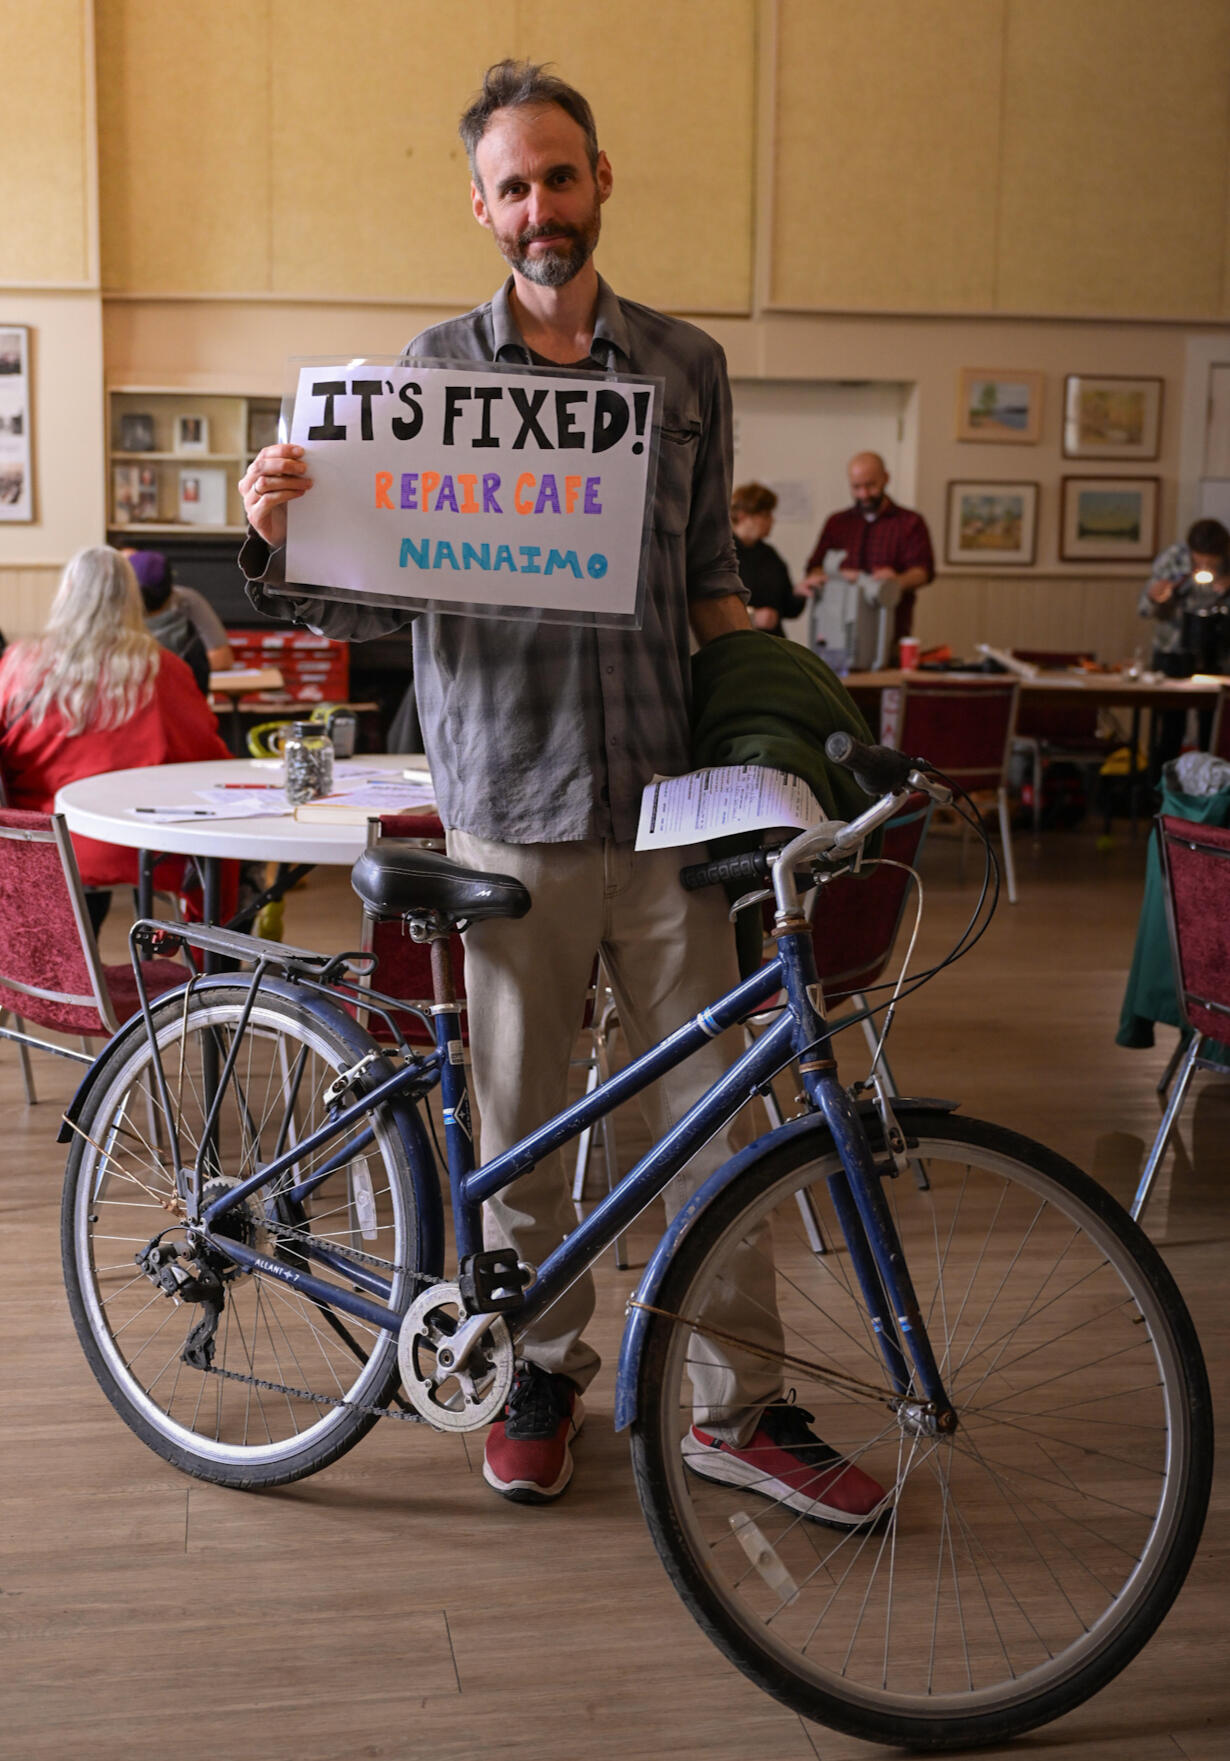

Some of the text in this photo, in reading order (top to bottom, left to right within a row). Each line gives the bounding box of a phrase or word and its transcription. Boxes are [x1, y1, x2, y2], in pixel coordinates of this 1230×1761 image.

[308, 380, 651, 456] IT'S FIXED!
[375, 471, 602, 515] REPAIR CAFE
[400, 538, 608, 579] NANAIMO
